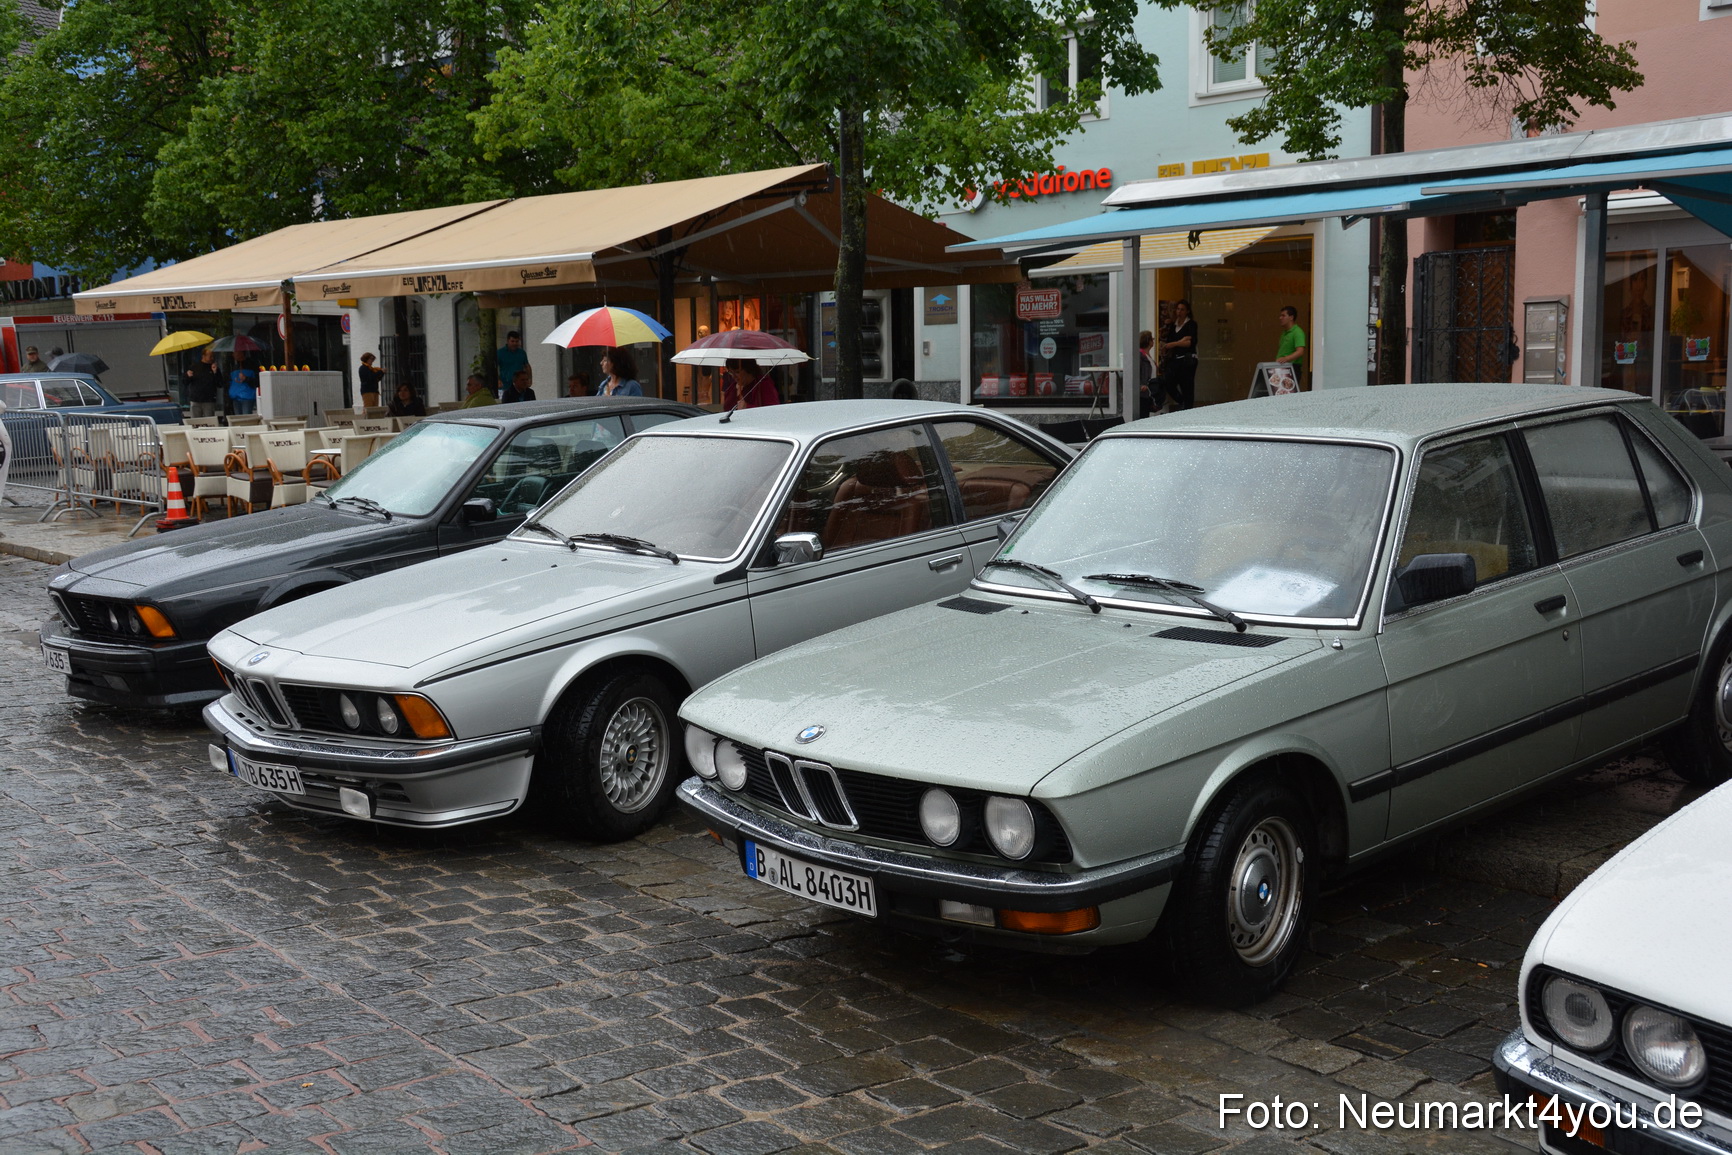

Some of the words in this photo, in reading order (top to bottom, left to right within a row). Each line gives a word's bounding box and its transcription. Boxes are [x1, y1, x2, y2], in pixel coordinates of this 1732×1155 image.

[403, 277, 413, 286] EIS
[413, 275, 448, 292] LORENZO
[448, 281, 463, 290] CAFE
[1020, 295, 1034, 303] WAS
[1035, 294, 1058, 302] WILLST
[1020, 303, 1030, 312] DU
[1032, 302, 1058, 311] MEHR?
[53, 314, 94, 323] FEUERWEHR
[103, 313, 115, 321] 112
[258, 766, 302, 791] 635H
[756, 848, 767, 877] B
[780, 857, 801, 892] AL
[805, 866, 872, 911] 8403H
